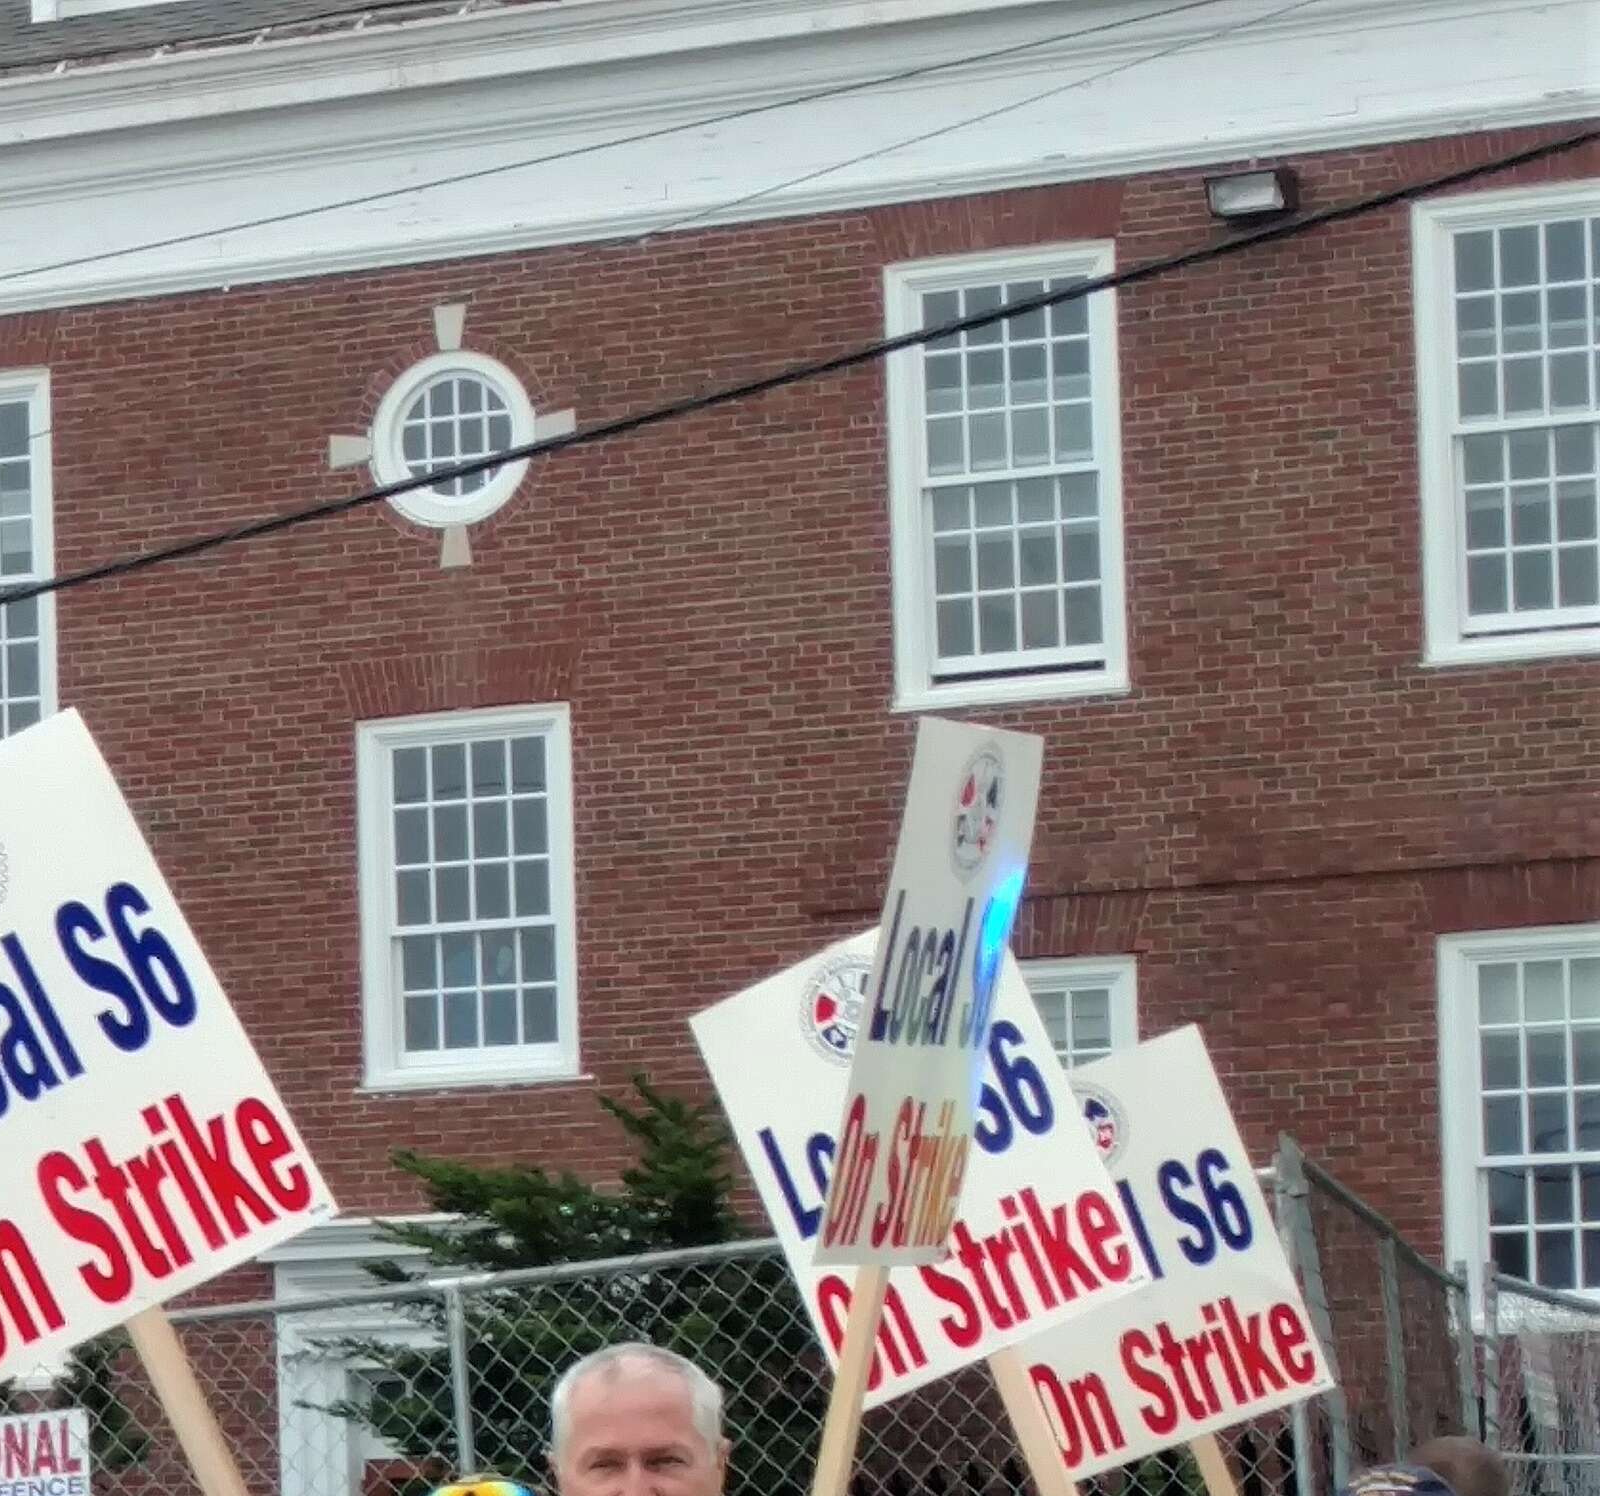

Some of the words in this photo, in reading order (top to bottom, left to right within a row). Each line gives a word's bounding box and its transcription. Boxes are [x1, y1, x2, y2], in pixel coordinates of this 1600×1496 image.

[55, 881, 197, 1051] S6
[869, 889, 976, 1046] Local
[38, 1093, 312, 1304] Strike
[823, 1093, 879, 1248] On
[1157, 1147, 1253, 1268] S6
[918, 1187, 1132, 1350] Strike
[1118, 1295, 1317, 1437] Strike
